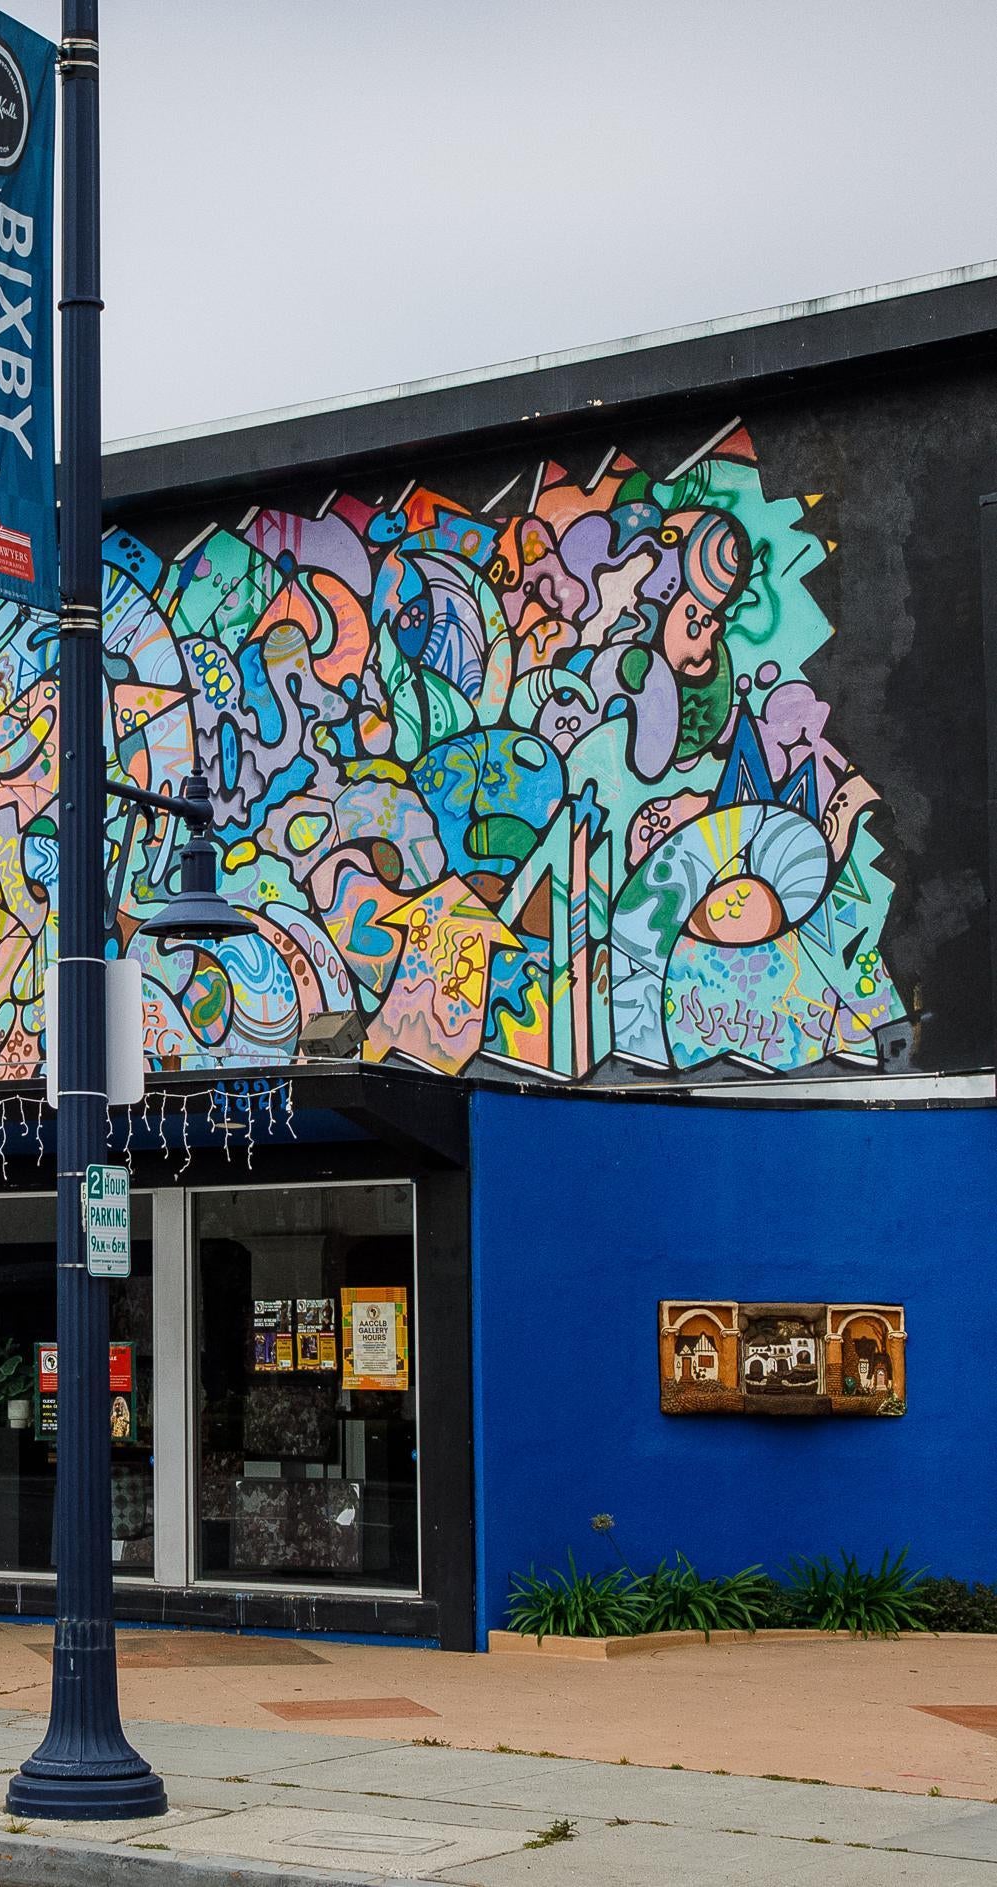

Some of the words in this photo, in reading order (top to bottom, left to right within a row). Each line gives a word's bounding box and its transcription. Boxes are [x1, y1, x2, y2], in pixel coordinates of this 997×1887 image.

[214, 1078, 288, 1113] 4321
[90, 1170, 101, 1195] 2
[104, 1176, 127, 1196] HOUR
[90, 1206, 127, 1228] PARKING
